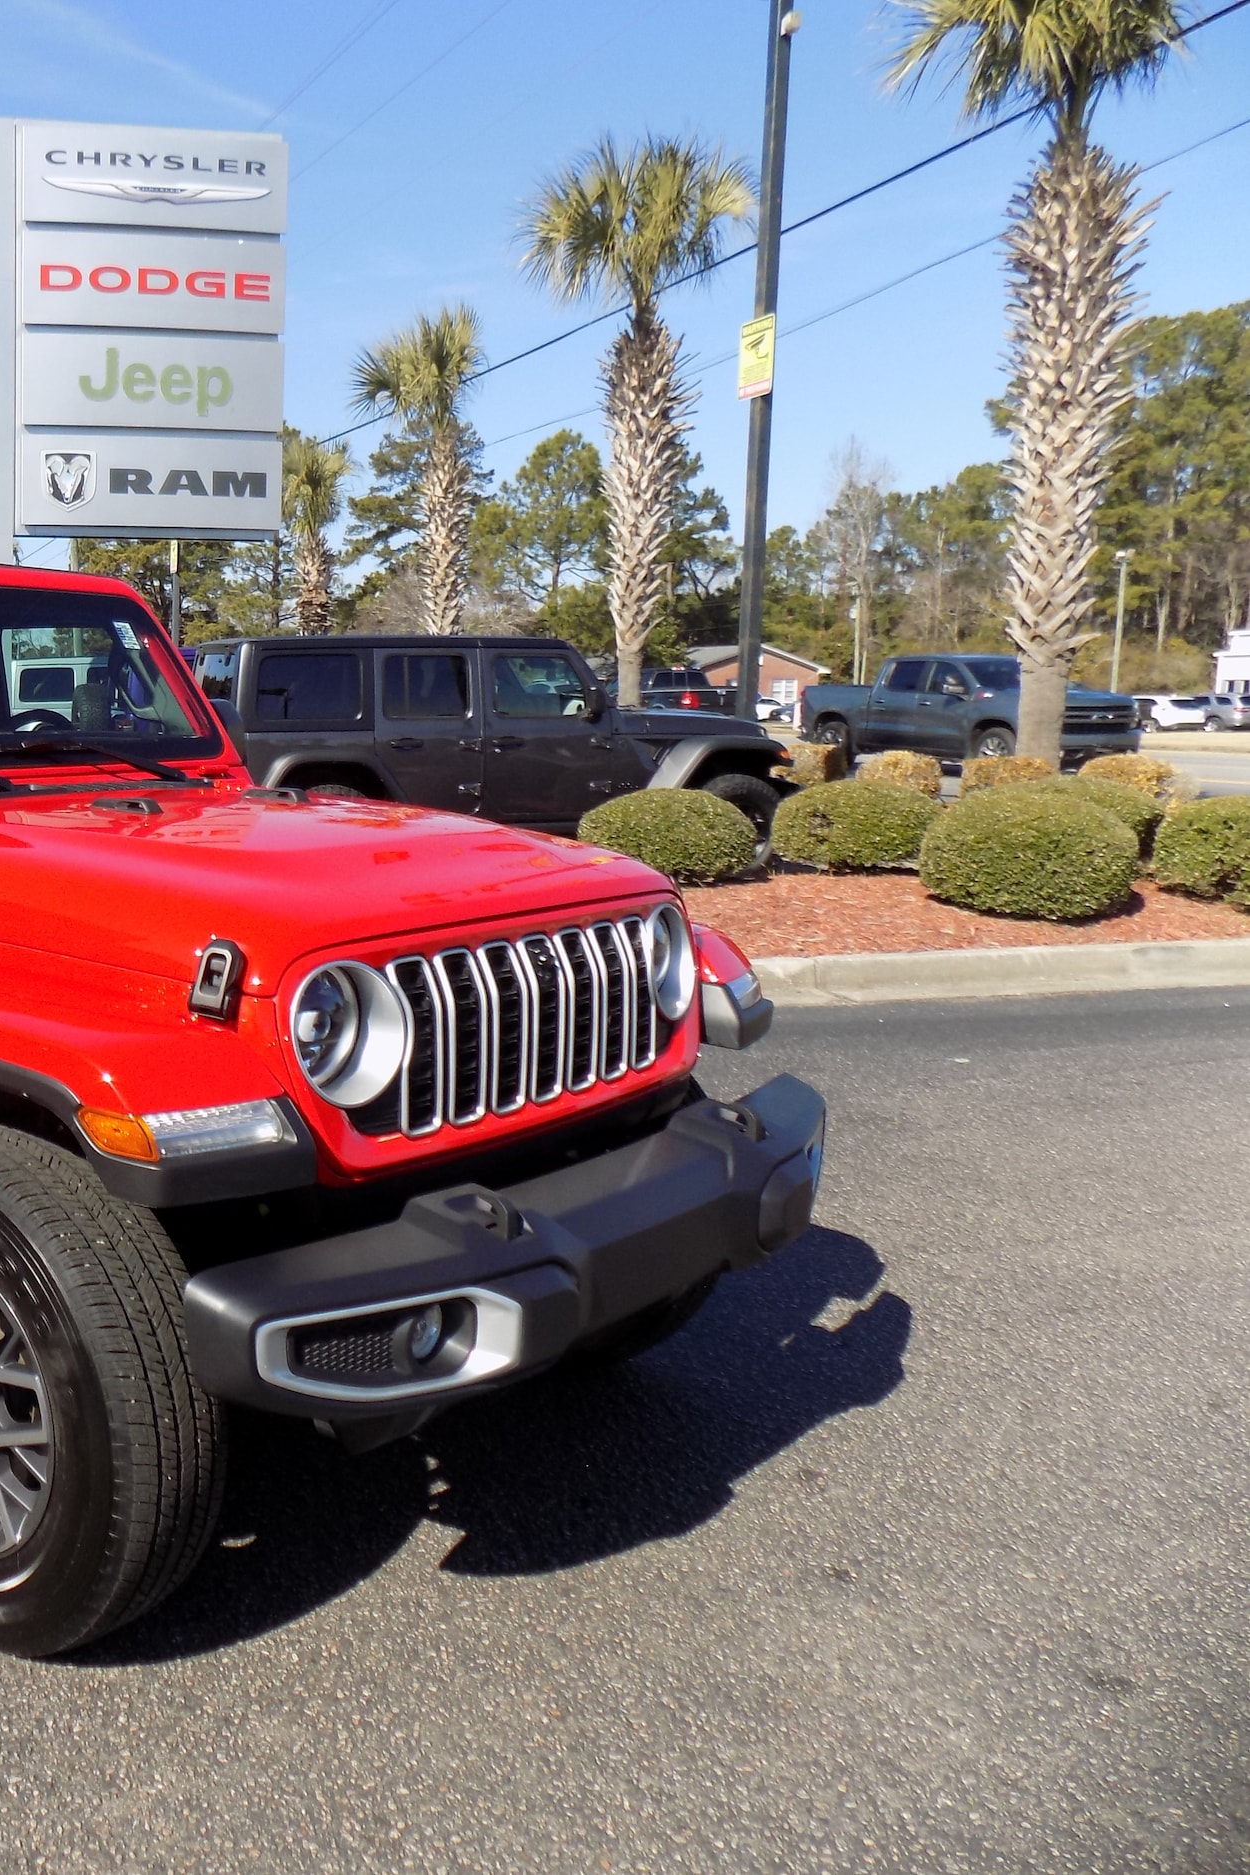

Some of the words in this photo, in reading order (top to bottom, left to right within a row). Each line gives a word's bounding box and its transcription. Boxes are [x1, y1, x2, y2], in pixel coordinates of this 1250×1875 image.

[45, 150, 267, 177] CHRYSLER
[40, 264, 271, 302] DODGE
[78, 347, 234, 417] Jeep
[109, 468, 267, 498] RAM
